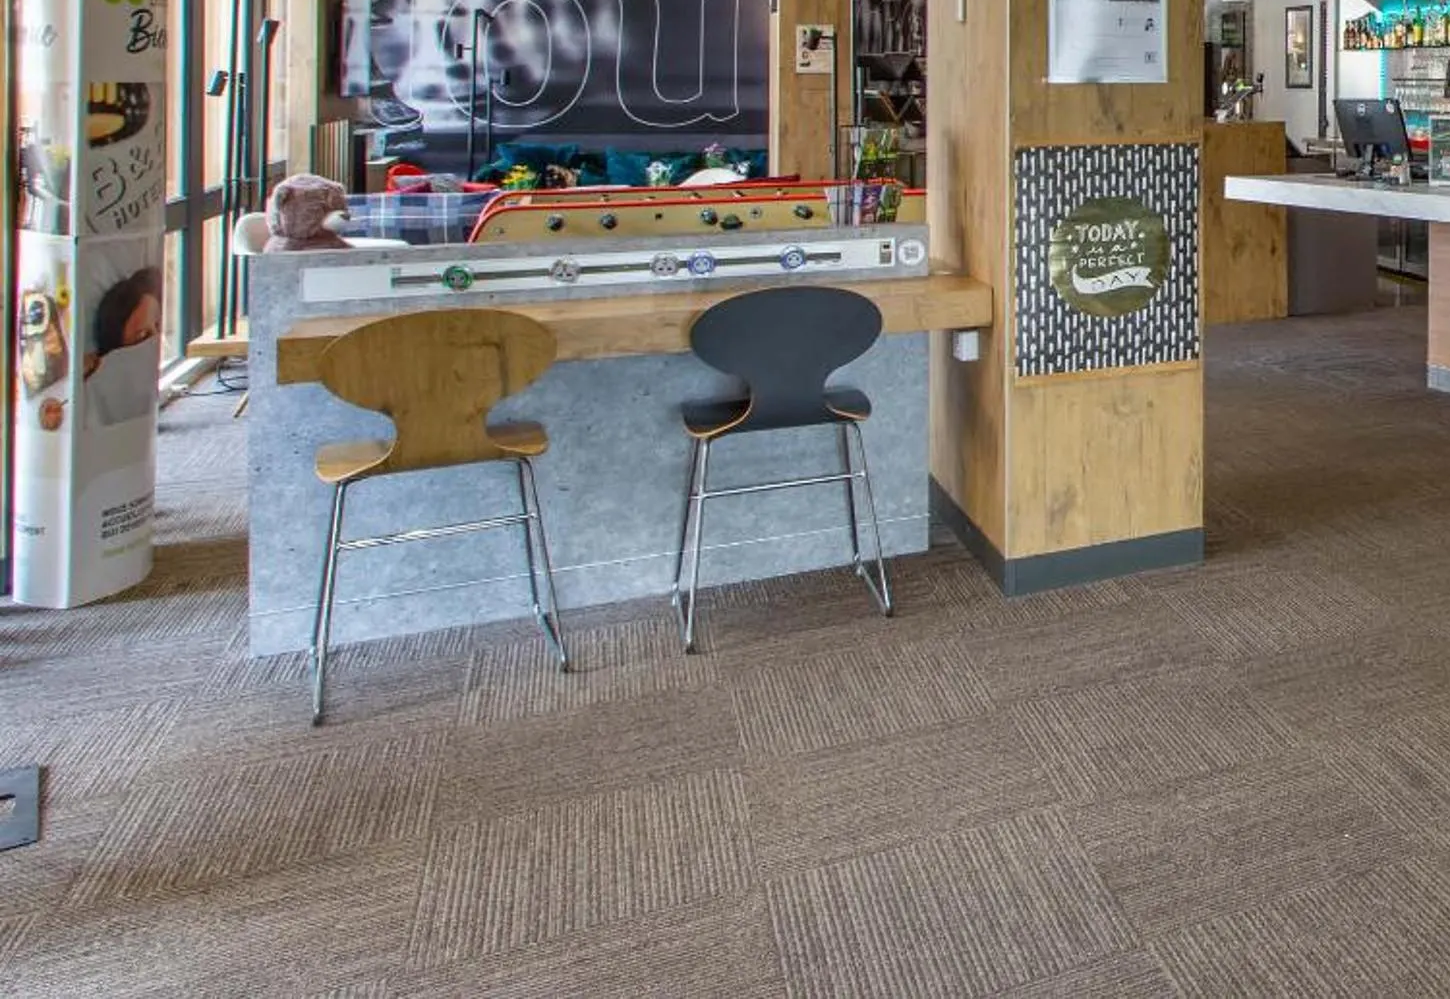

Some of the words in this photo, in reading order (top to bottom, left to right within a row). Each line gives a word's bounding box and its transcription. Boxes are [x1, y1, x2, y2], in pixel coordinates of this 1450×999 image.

[1075, 220, 1139, 243] TODAY
[1079, 252, 1145, 268] PERFECT
[1091, 271, 1138, 290] DAY
